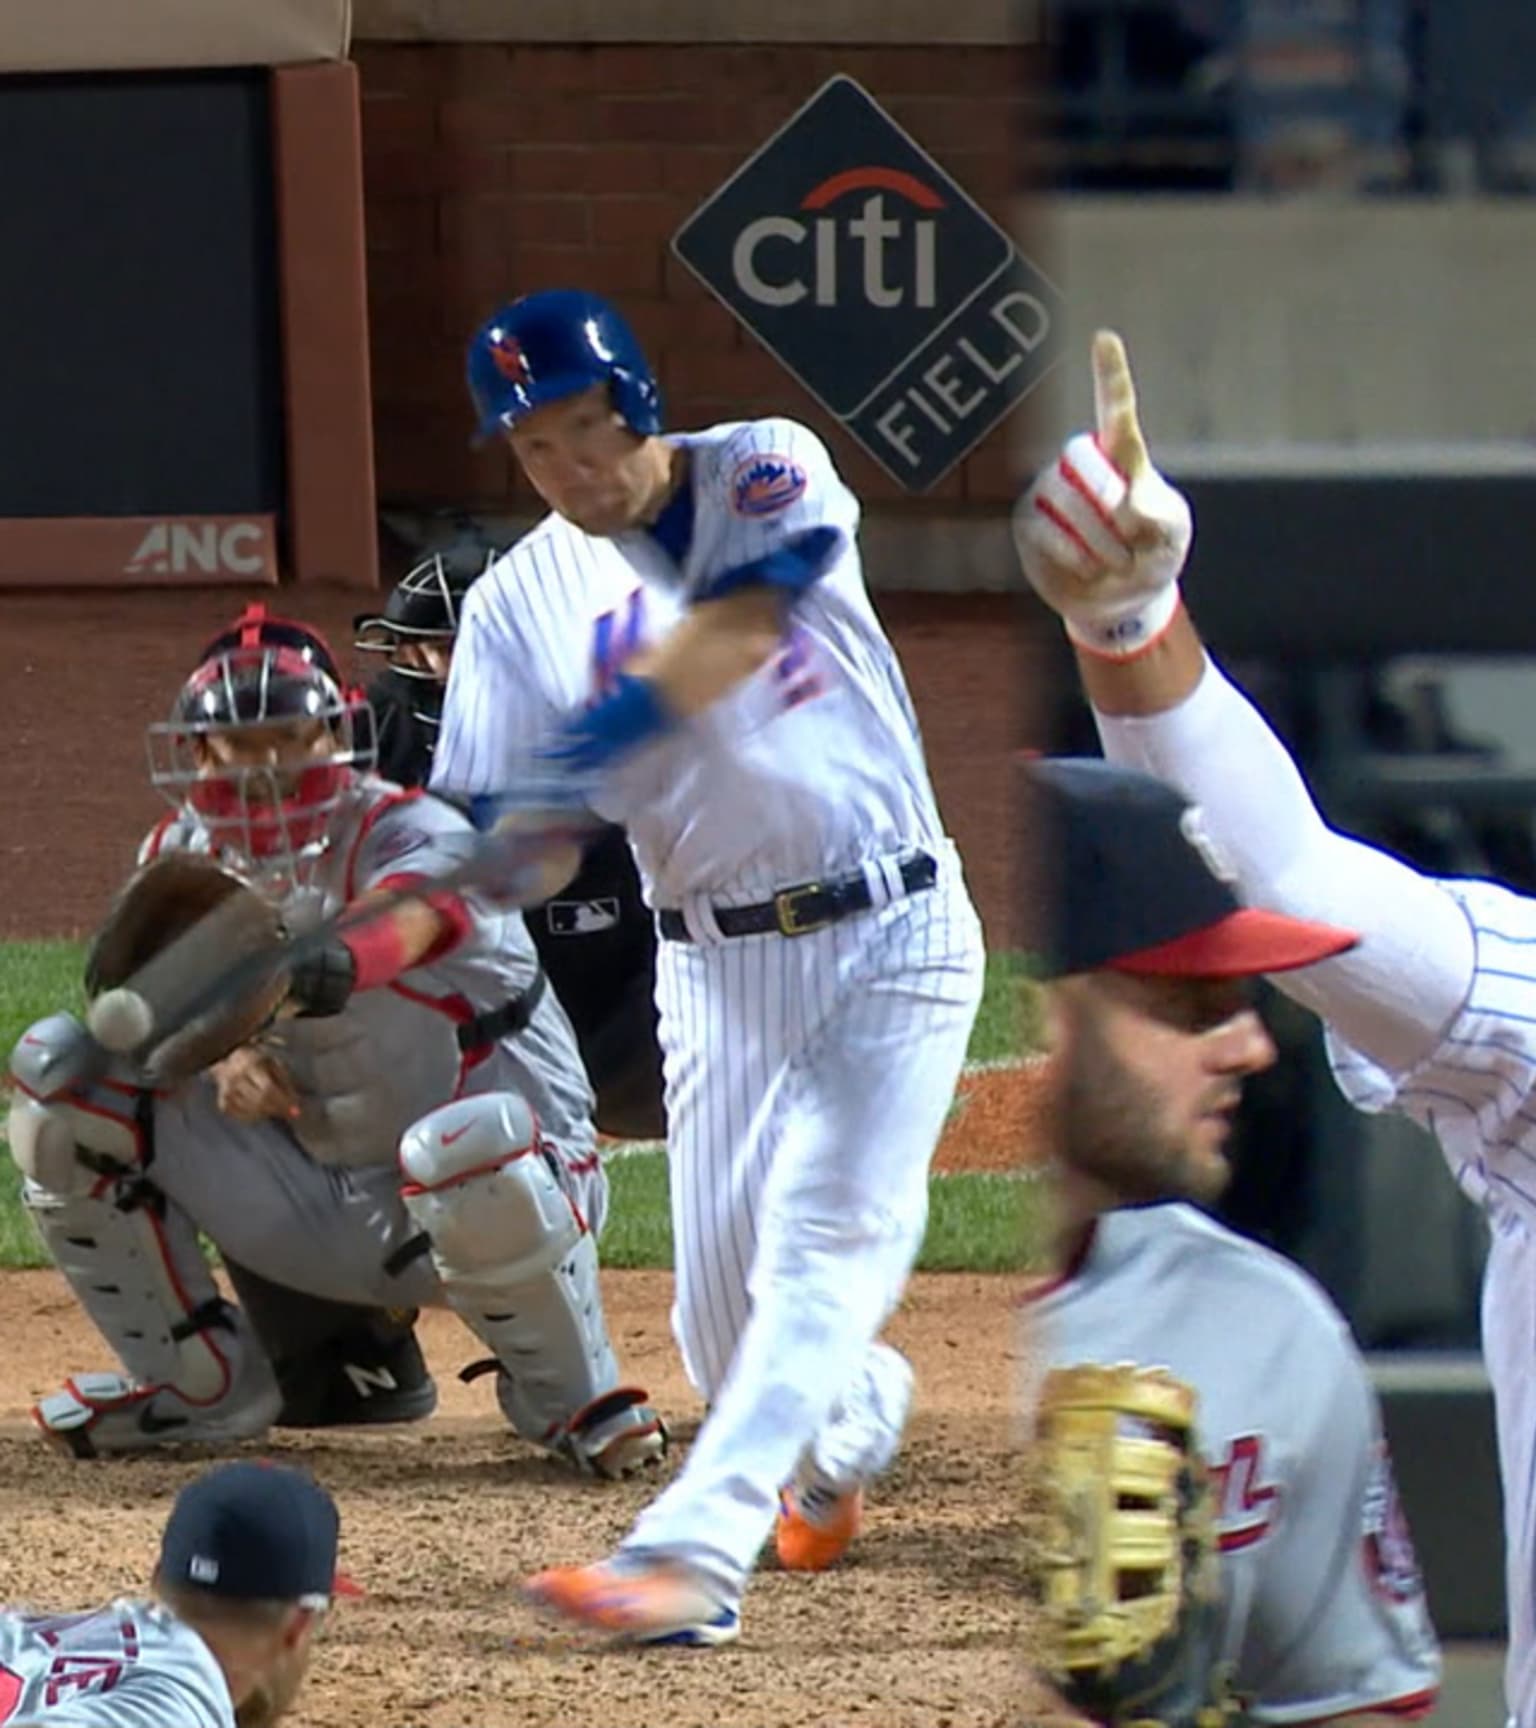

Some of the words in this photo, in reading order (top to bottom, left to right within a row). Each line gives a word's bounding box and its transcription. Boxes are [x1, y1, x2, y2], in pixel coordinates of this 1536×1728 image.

[875, 291, 1050, 467] FIELD
[123, 522, 262, 574] ANC
[344, 1363, 397, 1397] N
